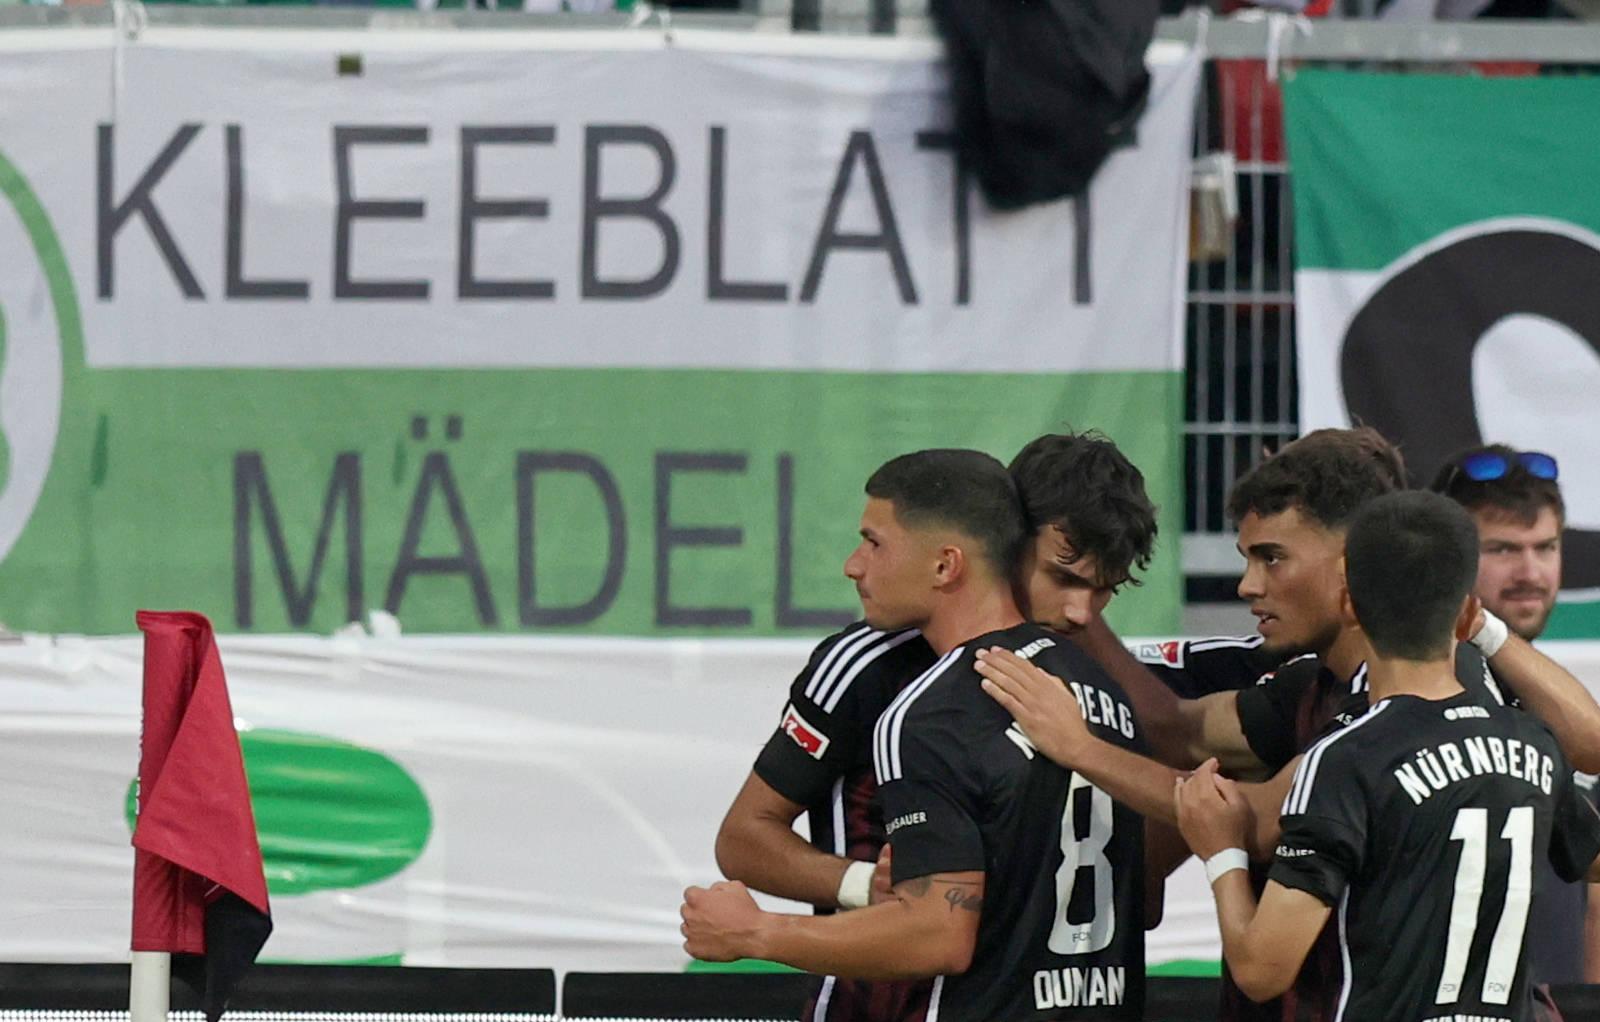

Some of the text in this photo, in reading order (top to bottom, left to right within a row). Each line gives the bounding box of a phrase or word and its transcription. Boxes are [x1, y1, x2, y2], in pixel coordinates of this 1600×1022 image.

[1047, 768, 1117, 955] 8
[1394, 736, 1553, 806] NÜRNBERG
[1434, 806, 1535, 1006] 11
